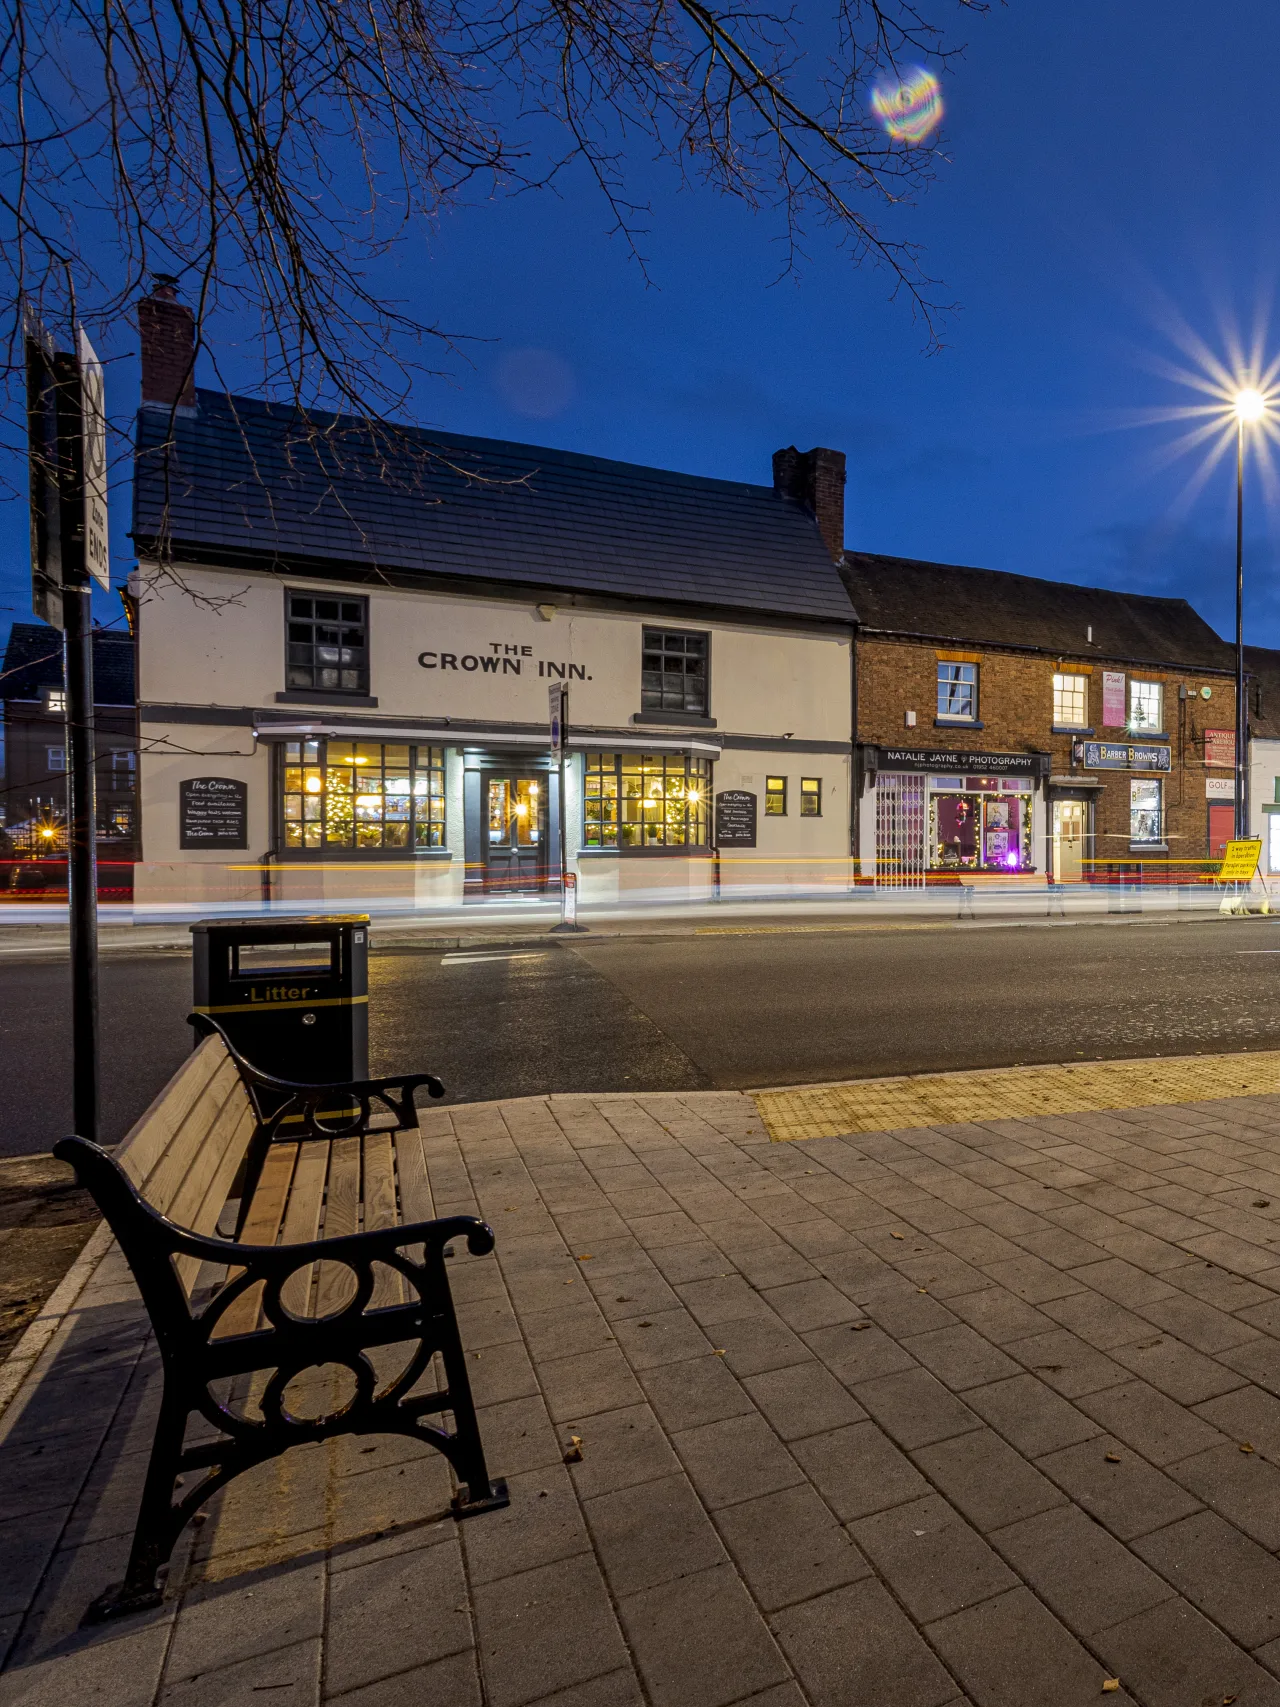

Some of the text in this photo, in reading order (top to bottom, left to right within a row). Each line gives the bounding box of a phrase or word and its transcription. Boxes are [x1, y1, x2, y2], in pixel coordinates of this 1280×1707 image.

[90, 527, 107, 574] ENDS
[489, 642, 533, 657] THE
[418, 652, 593, 681] CROWN INN.
[887, 752, 1032, 766] NATALIE JAYNE PHOTOGRAPHY
[1100, 746, 1158, 762] BARBER BROWNS
[192, 780, 236, 790] The Crown
[1208, 781, 1228, 789] GOLF
[250, 987, 310, 1001] Litter
